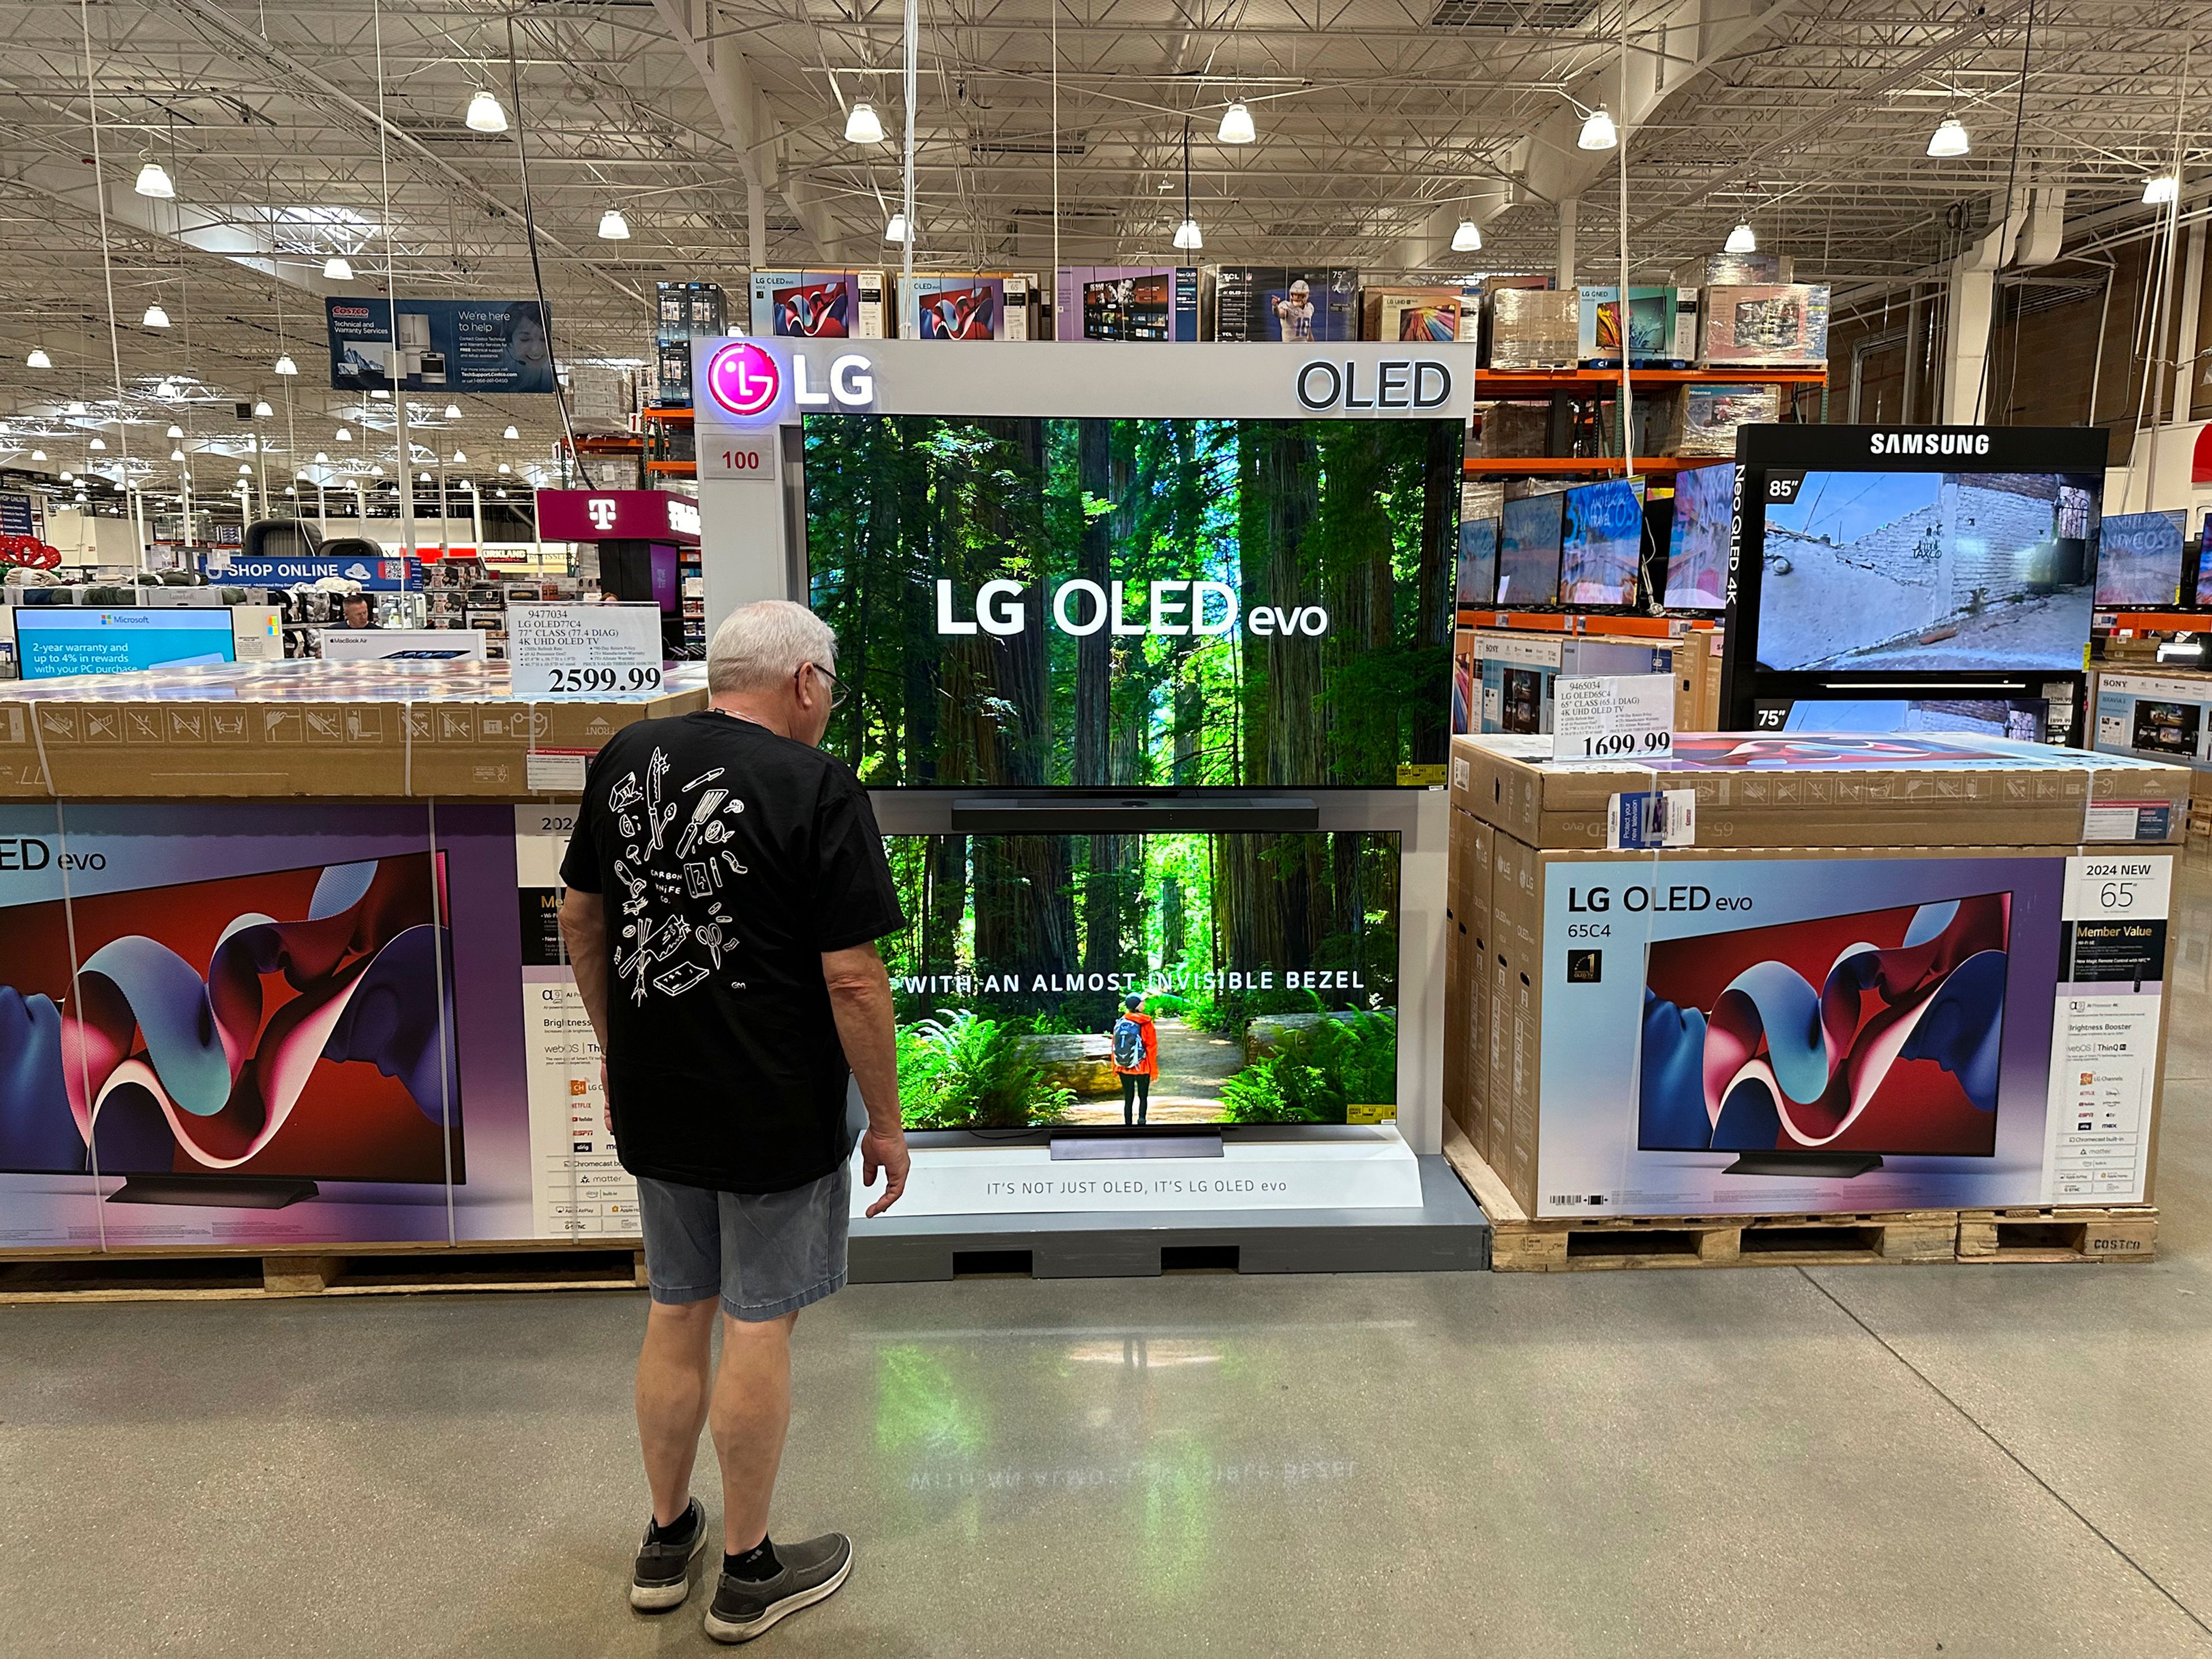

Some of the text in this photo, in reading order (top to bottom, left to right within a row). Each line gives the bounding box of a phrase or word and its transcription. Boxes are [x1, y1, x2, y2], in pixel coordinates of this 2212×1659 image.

[458, 311, 510, 320] We're here
[459, 323, 493, 333] to help
[793, 354, 874, 405] LG
[1296, 361, 1452, 411] OLED
[1870, 434, 1990, 454] SAMSUNG
[722, 451, 759, 469] 100
[1769, 480, 1798, 497] 85"
[1726, 464, 1745, 605] Neo QLED 4K
[1912, 548, 1942, 563] TAXCO
[228, 563, 339, 577] SHOP ONLINE
[937, 578, 1328, 637] LG OLED evo
[33, 643, 128, 653] 2-year warranty and
[1486, 644, 1498, 653] SONY
[34, 656, 44, 664] up
[62, 654, 77, 662] 4%
[80, 654, 89, 662] in
[91, 654, 128, 662] rewards
[35, 665, 137, 675] with your PC purchase
[548, 668, 661, 692] 2599.99
[1570, 681, 1600, 690] 9465034
[1574, 691, 1611, 699] OLED65C4
[1600, 698, 1616, 707] (65.1
[1619, 697, 1639, 705] DIAG)
[1758, 710, 1786, 726] 75"
[1583, 732, 1670, 759] 1699.99
[1562, 822, 1584, 830] evo
[58, 853, 106, 870] evo
[651, 869, 683, 880] CARBON
[2086, 865, 2151, 875] 2024 NEW
[1526, 876, 1533, 889] LG
[661, 896, 671, 904] CO.
[1568, 887, 1753, 912] LG OLED evo
[1517, 925, 1529, 941] OLED
[1568, 924, 1611, 938] 65C4
[2077, 926, 2152, 937] Member Value
[903, 970, 1365, 994] WITH AN ALMOST INVISIBLE BEZEL
[544, 1044, 579, 1053] webOS
[2066, 1044, 2091, 1052] webOS
[987, 1180, 1287, 1195] IT'S NOT JUST OLED, IT'S LG OLED evo
[2094, 1239, 2141, 1249] COSTCO
